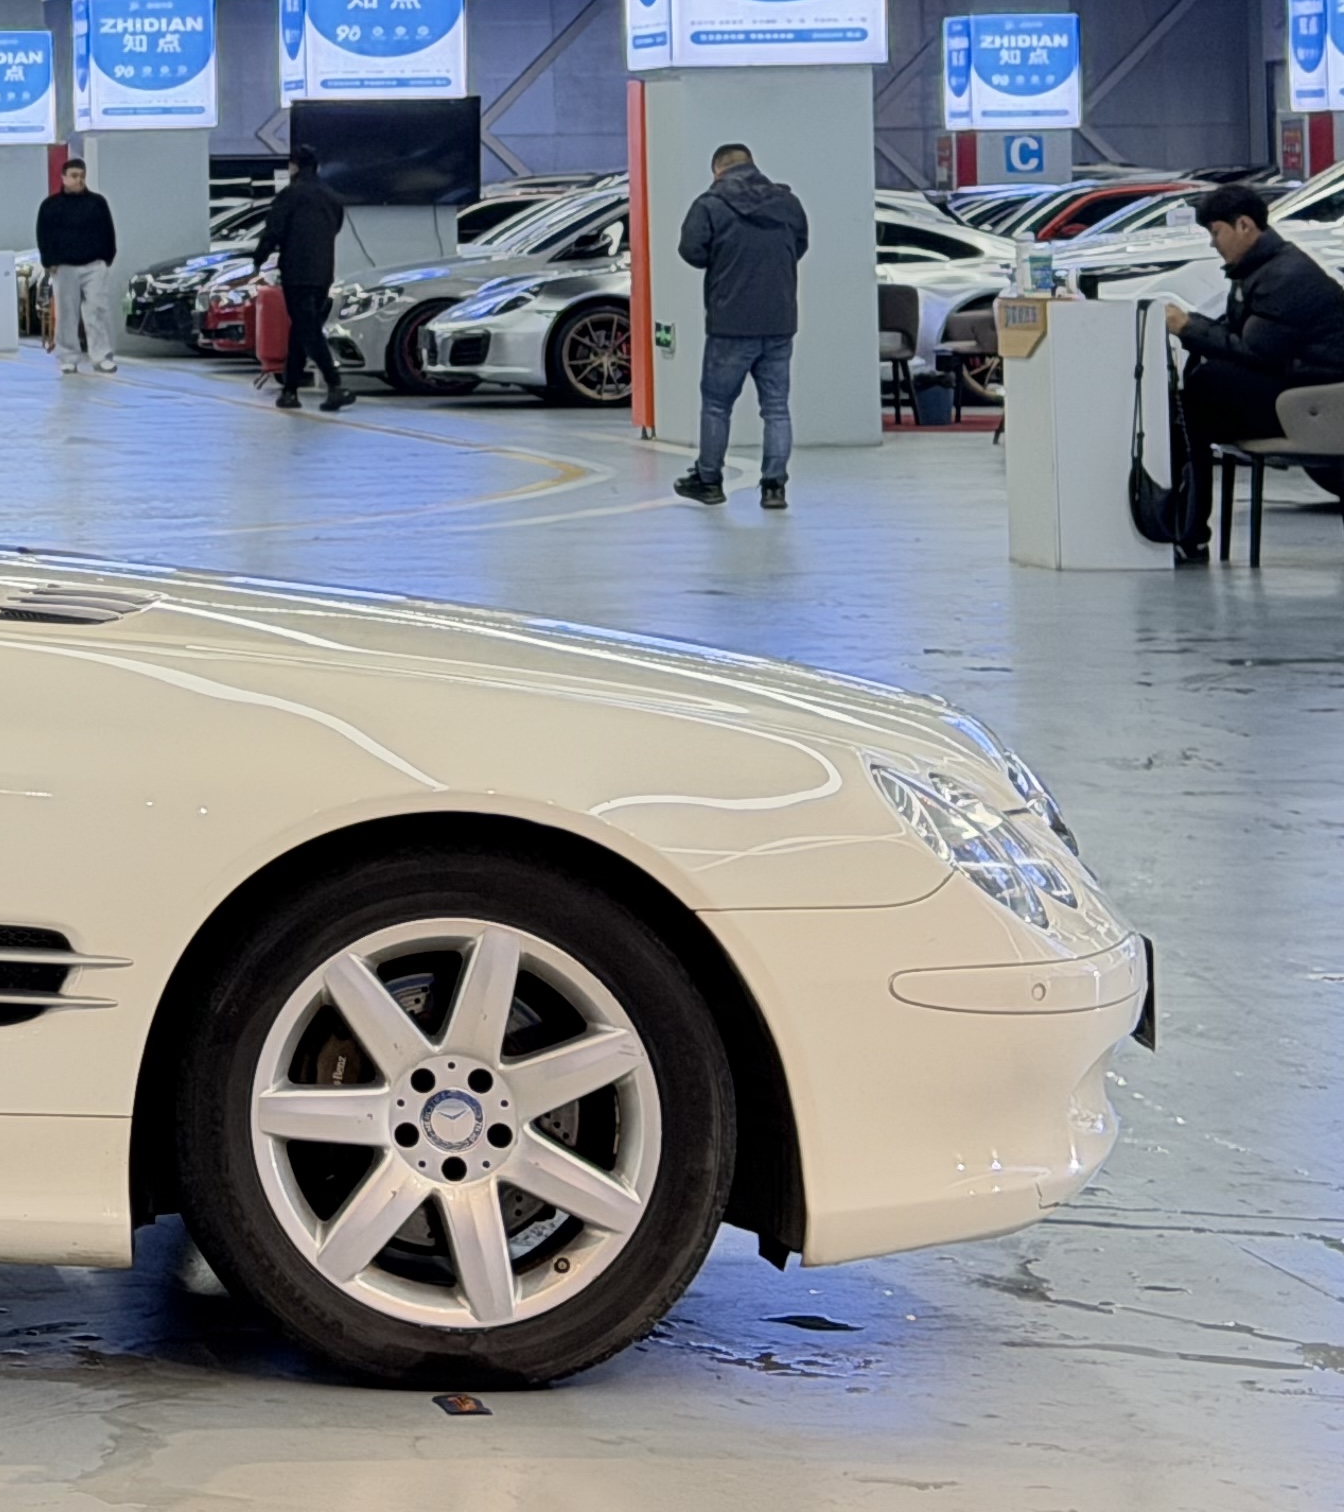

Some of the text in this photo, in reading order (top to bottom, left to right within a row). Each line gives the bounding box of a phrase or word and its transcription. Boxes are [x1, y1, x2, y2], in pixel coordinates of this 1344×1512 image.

[100, 16, 203, 33] ZHIDIAN
[123, 33, 181, 52] 知点
[980, 34, 1068, 48] ZHIDIAN
[1000, 48, 1049, 65] 知点
[1010, 136, 1040, 172] C
